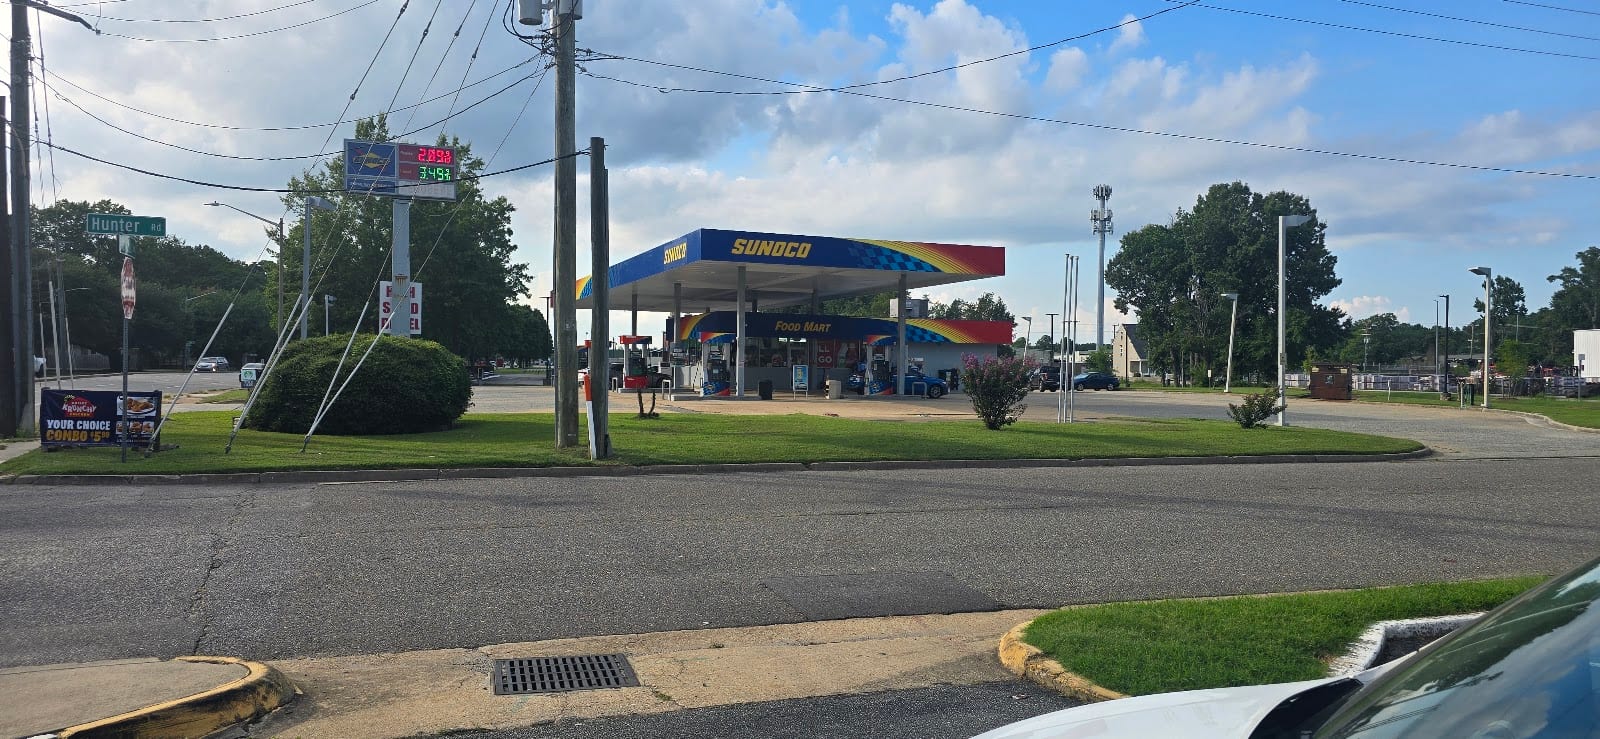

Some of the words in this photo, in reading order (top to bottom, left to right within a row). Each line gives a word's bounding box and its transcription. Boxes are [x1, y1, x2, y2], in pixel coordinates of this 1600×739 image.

[91, 217, 140, 232] Hunter
[151, 223, 161, 232] Rd
[663, 242, 687, 265] SUNOCO
[731, 238, 812, 259] SUNOCO
[775, 320, 801, 331] FOOD
[803, 321, 832, 333] MART
[818, 355, 833, 364] GO
[62, 403, 97, 413] KRUNCHY
[46, 419, 74, 430] YOUR
[76, 420, 111, 431] CHOICE
[46, 429, 88, 441] COMBO
